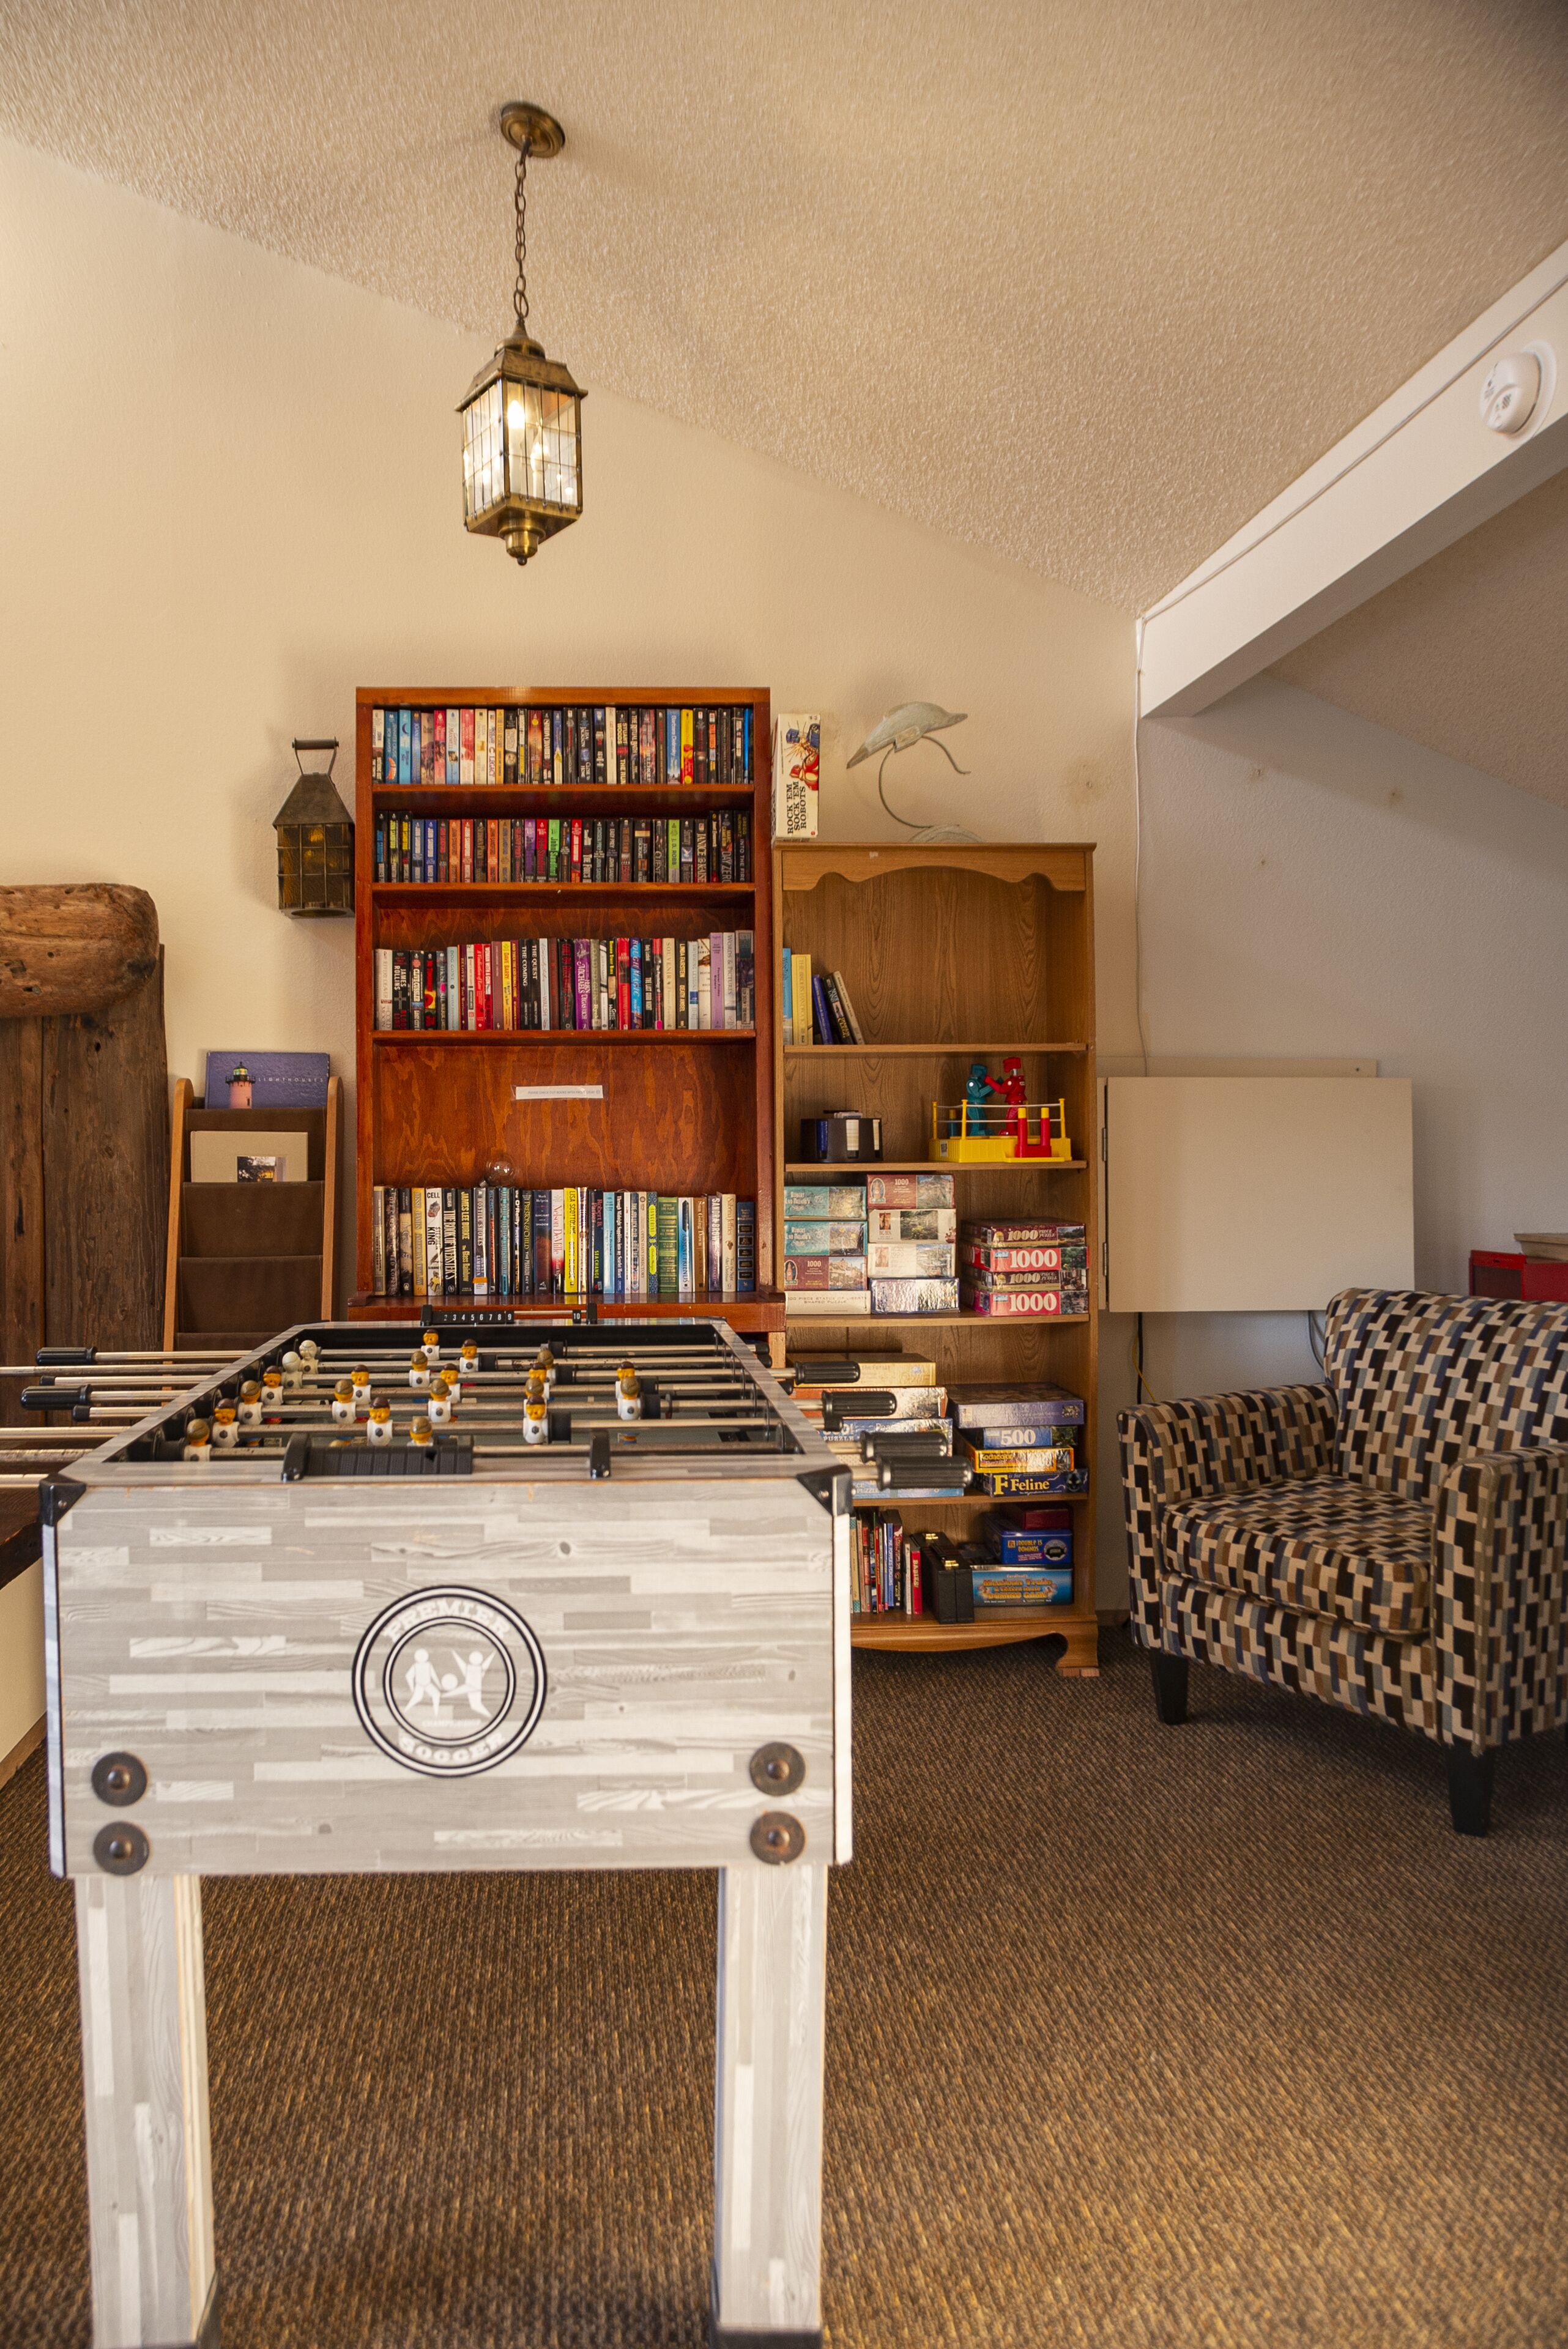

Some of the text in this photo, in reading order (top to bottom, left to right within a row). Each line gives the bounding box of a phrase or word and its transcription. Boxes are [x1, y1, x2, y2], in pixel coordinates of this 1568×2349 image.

[549, 852, 558, 876] Sandford
[577, 961, 585, 993] MICHAELS
[461, 1192, 469, 1211] JAMES
[712, 1198, 720, 1222] SANDRA
[552, 1204, 562, 1255] Nelson DeMille
[726, 1218, 735, 1236] Jeffries
[1008, 1230, 1039, 1241] 1000
[444, 1209, 456, 1280] THE BOOK OF WEBSTER'S
[1010, 1250, 1058, 1268] 1000
[1009, 1272, 1041, 1284] 1000
[1009, 1293, 1057, 1312] 1000
[1000, 1430, 1036, 1445] 500
[994, 1475, 1009, 1495] F
[1010, 1479, 1050, 1491] Feline
[382, 1598, 510, 1644] PREMIER
[399, 1732, 505, 1762] SOCCER
